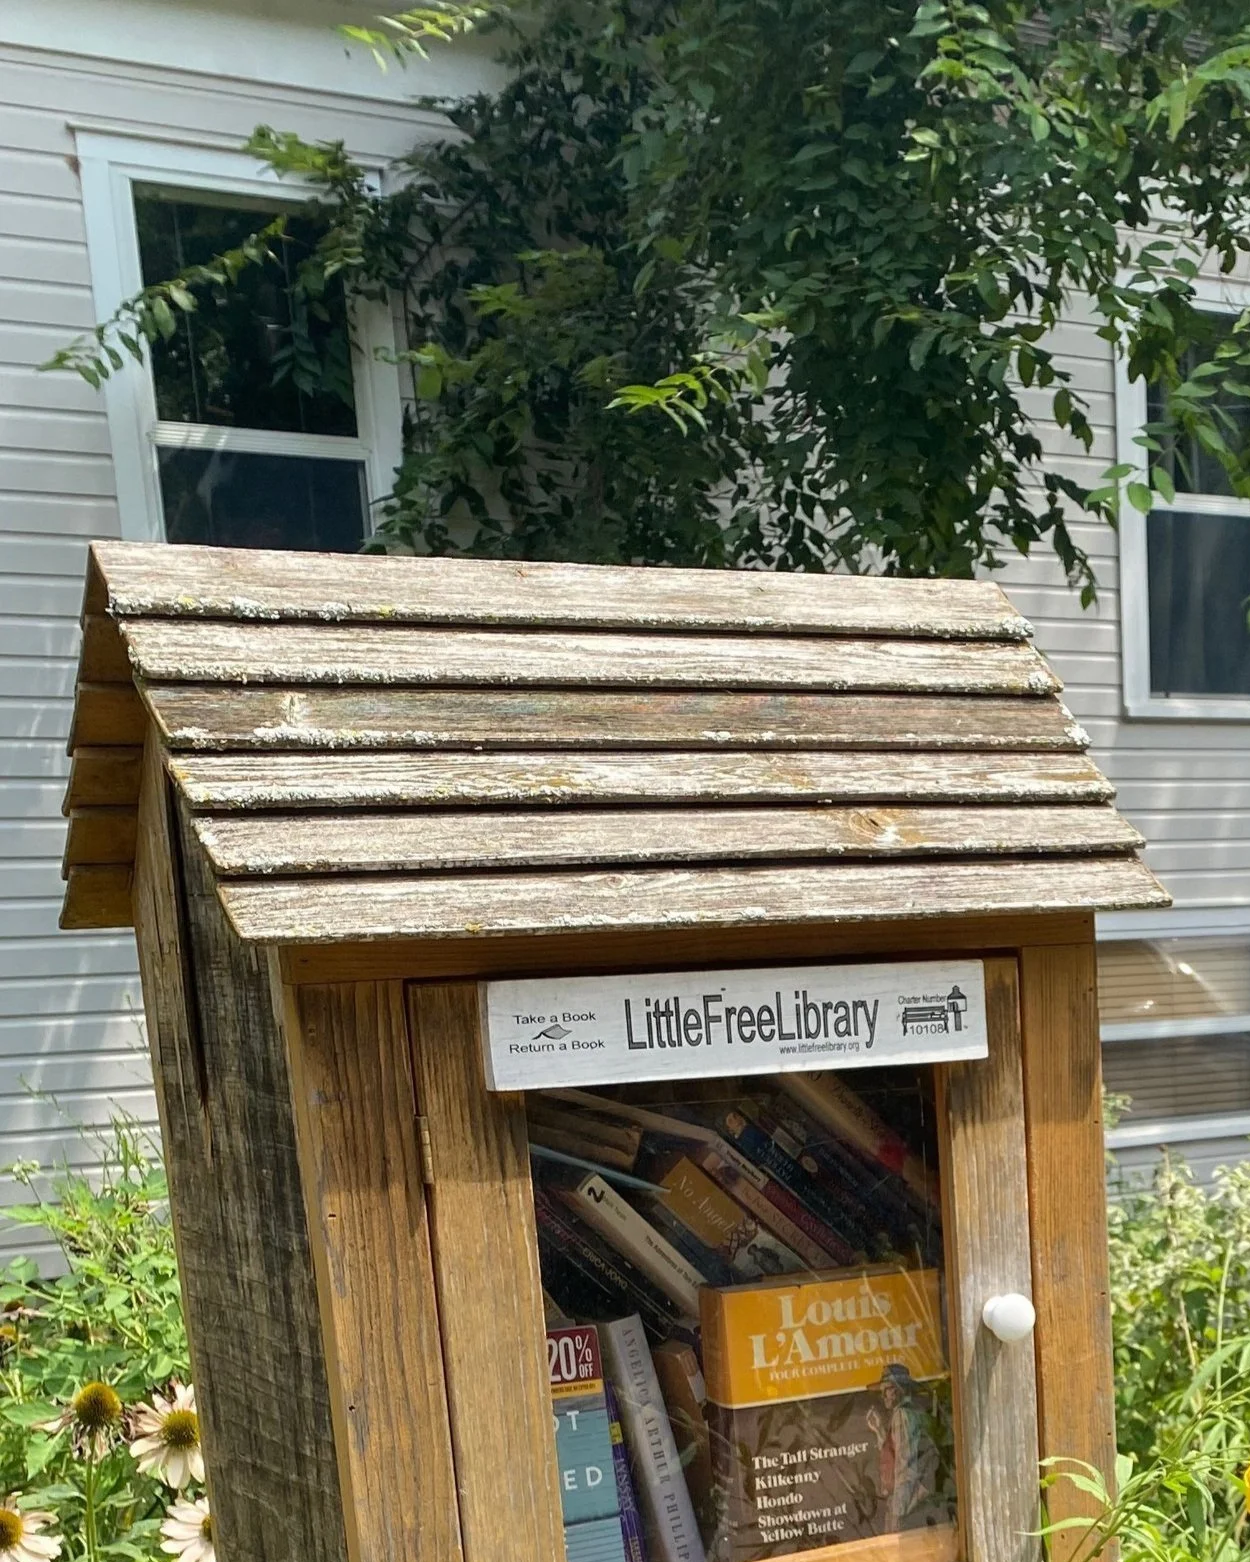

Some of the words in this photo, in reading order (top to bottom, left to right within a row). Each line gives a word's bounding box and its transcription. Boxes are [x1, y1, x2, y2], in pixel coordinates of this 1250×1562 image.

[512, 1014, 546, 1024] Take
[549, 1015, 558, 1023] a
[562, 1011, 596, 1022] Book
[624, 990, 879, 1050] LittleFreeLibrary
[509, 1043, 555, 1054] Return
[571, 1040, 605, 1050] Book
[588, 1187, 605, 1203] 2
[778, 1285, 892, 1330] Louis
[749, 1320, 922, 1369] L'Amour
[579, 1363, 593, 1378] OFF
[769, 1366, 801, 1381] FOUR
[802, 1360, 860, 1377] COMPLETE
[644, 1416, 671, 1484] ARTHUR
[752, 1456, 779, 1470] The
[779, 1450, 807, 1469] Tall
[810, 1442, 868, 1460] Stranger
[755, 1470, 821, 1490] Kilkenny
[756, 1492, 804, 1510] Hondo
[758, 1506, 831, 1528] Showdown
[834, 1503, 847, 1515] at
[760, 1527, 804, 1543] Yellow
[807, 1519, 845, 1535] Butte
